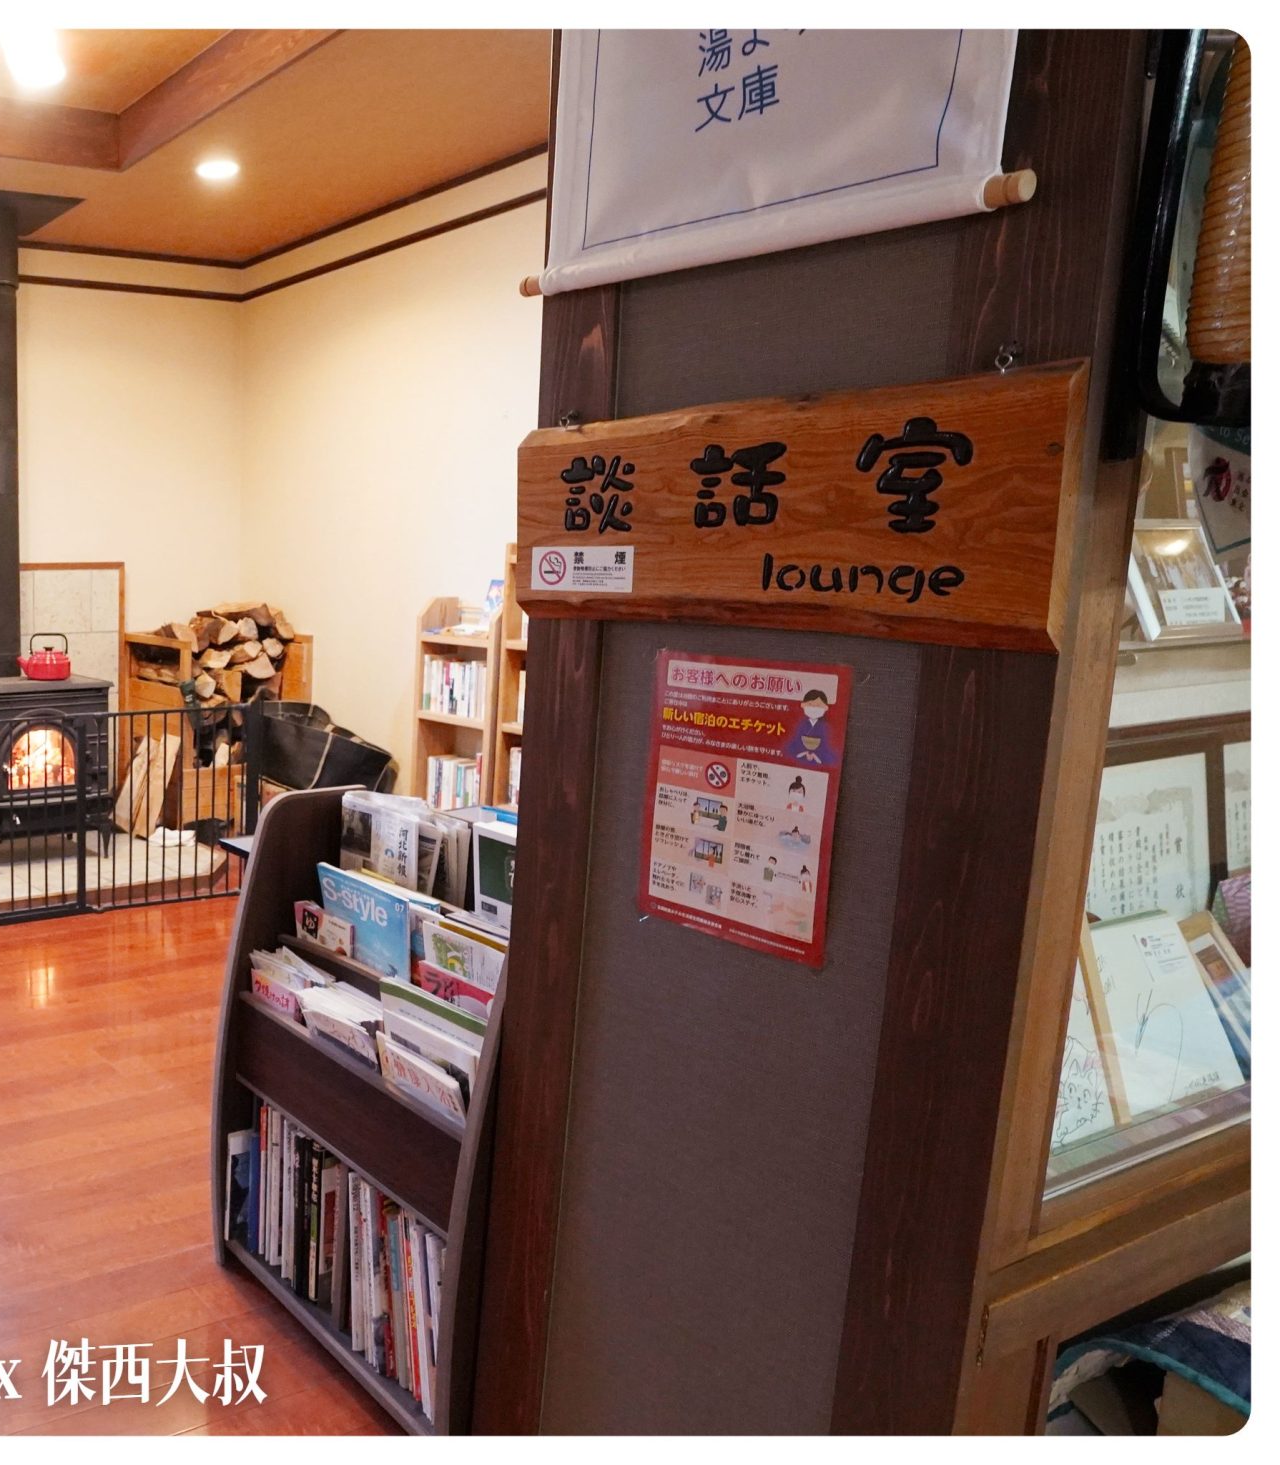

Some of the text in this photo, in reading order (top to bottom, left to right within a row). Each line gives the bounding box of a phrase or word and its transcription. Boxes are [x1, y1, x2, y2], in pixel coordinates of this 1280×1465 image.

[698, 29, 806, 77] 湯よ
[695, 65, 780, 132] 文庫
[560, 417, 974, 534] 談話室
[761, 553, 966, 603] lounge
[672, 667, 802, 693] お客様へのお願い
[662, 707, 786, 736] 新しい宿泊のエチケット
